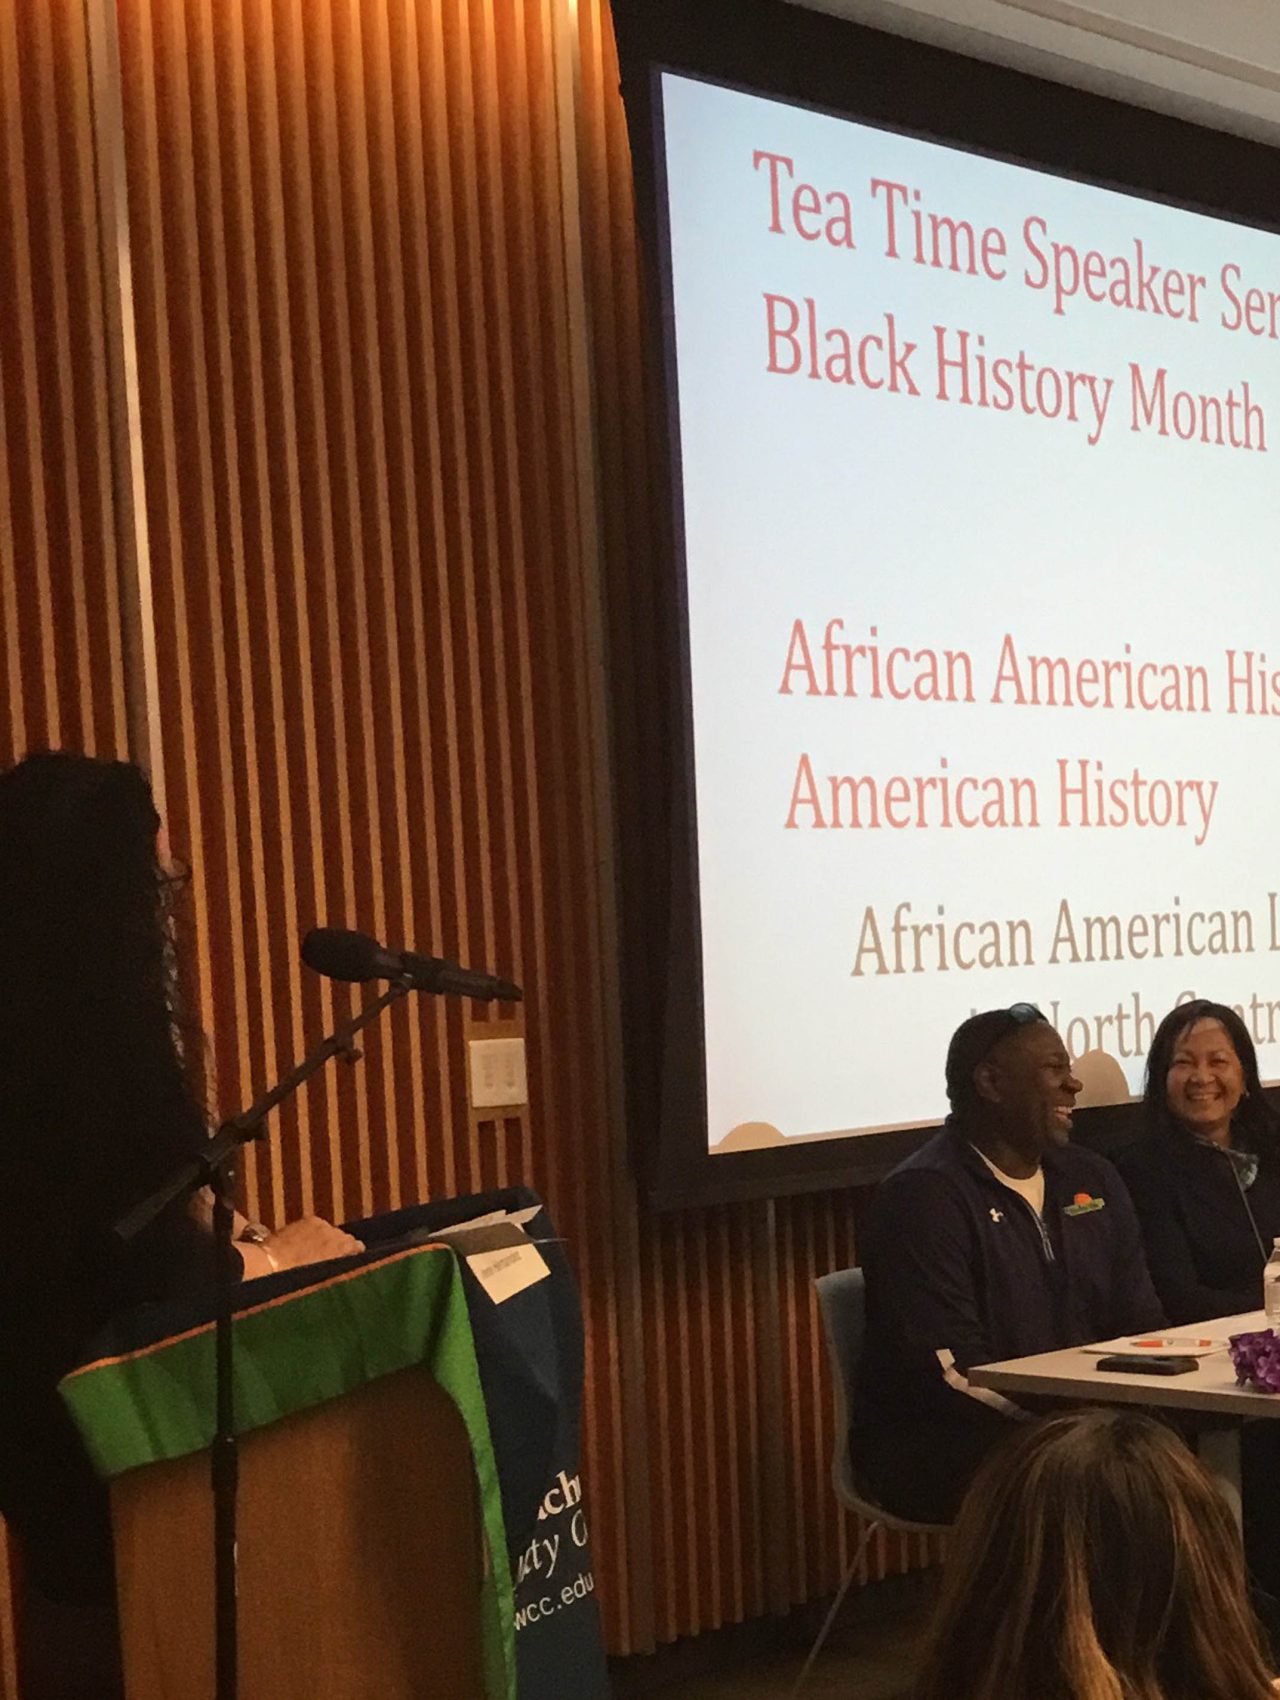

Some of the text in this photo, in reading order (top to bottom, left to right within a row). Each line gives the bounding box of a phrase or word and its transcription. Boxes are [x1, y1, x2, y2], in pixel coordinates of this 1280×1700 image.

[753, 150, 855, 249] Tea
[871, 178, 1006, 280] Time
[1023, 216, 1206, 323] Speaker
[763, 293, 1267, 452] Black History Month
[778, 619, 975, 702] African
[990, 634, 1211, 712] American
[784, 753, 1218, 846] American History
[851, 902, 1035, 976] African
[1048, 896, 1255, 964] American
